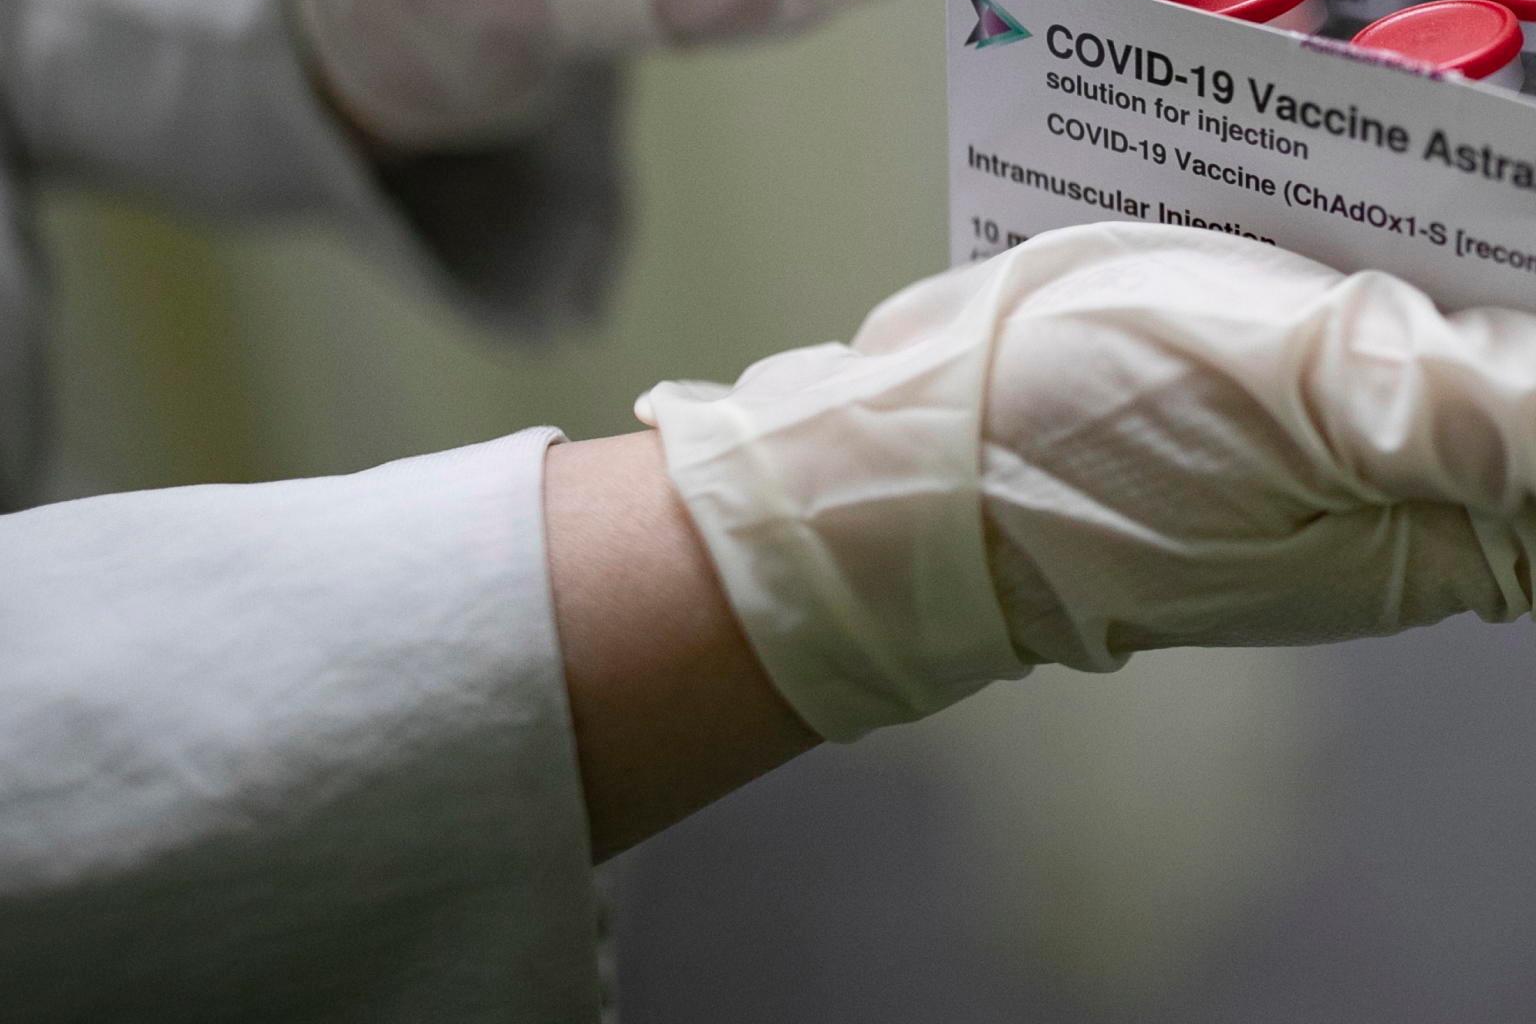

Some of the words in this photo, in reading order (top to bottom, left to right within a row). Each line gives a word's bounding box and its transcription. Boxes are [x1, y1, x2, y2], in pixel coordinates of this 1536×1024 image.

[1046, 24, 1234, 105] COVID-19
[1248, 78, 1410, 154] Vaccine
[1046, 71, 1146, 115] solution
[1154, 97, 1190, 127] for
[1198, 109, 1309, 160] injection
[967, 145, 1150, 219] Intramuscular
[1047, 113, 1167, 164] COVID-19
[1175, 147, 1276, 196] Vaccine
[1283, 179, 1448, 246] (ChAdOx1-S
[972, 216, 999, 244] 10
